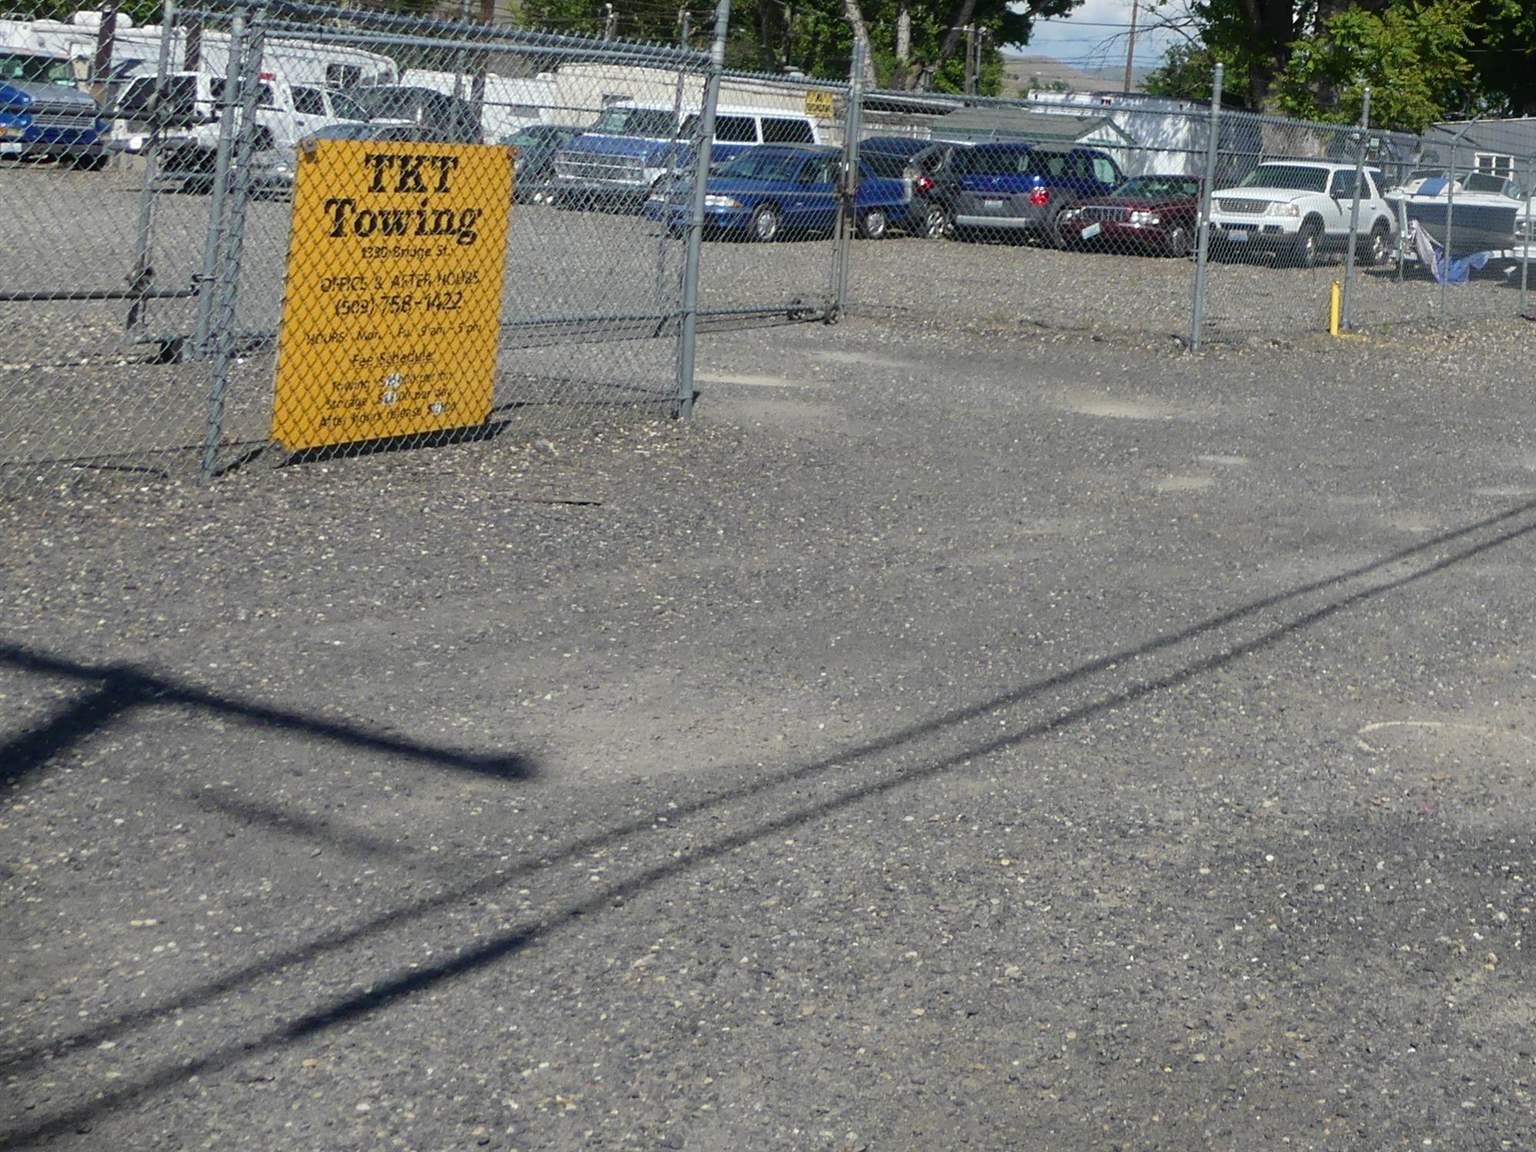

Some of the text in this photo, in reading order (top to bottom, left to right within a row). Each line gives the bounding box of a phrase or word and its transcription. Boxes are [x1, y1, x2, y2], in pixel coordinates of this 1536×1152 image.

[365, 153, 458, 194] TKT
[325, 196, 482, 246] Towing
[321, 271, 481, 292] OFFICE & AFTER HOURS
[335, 291, 463, 316] (509) 758-1422
